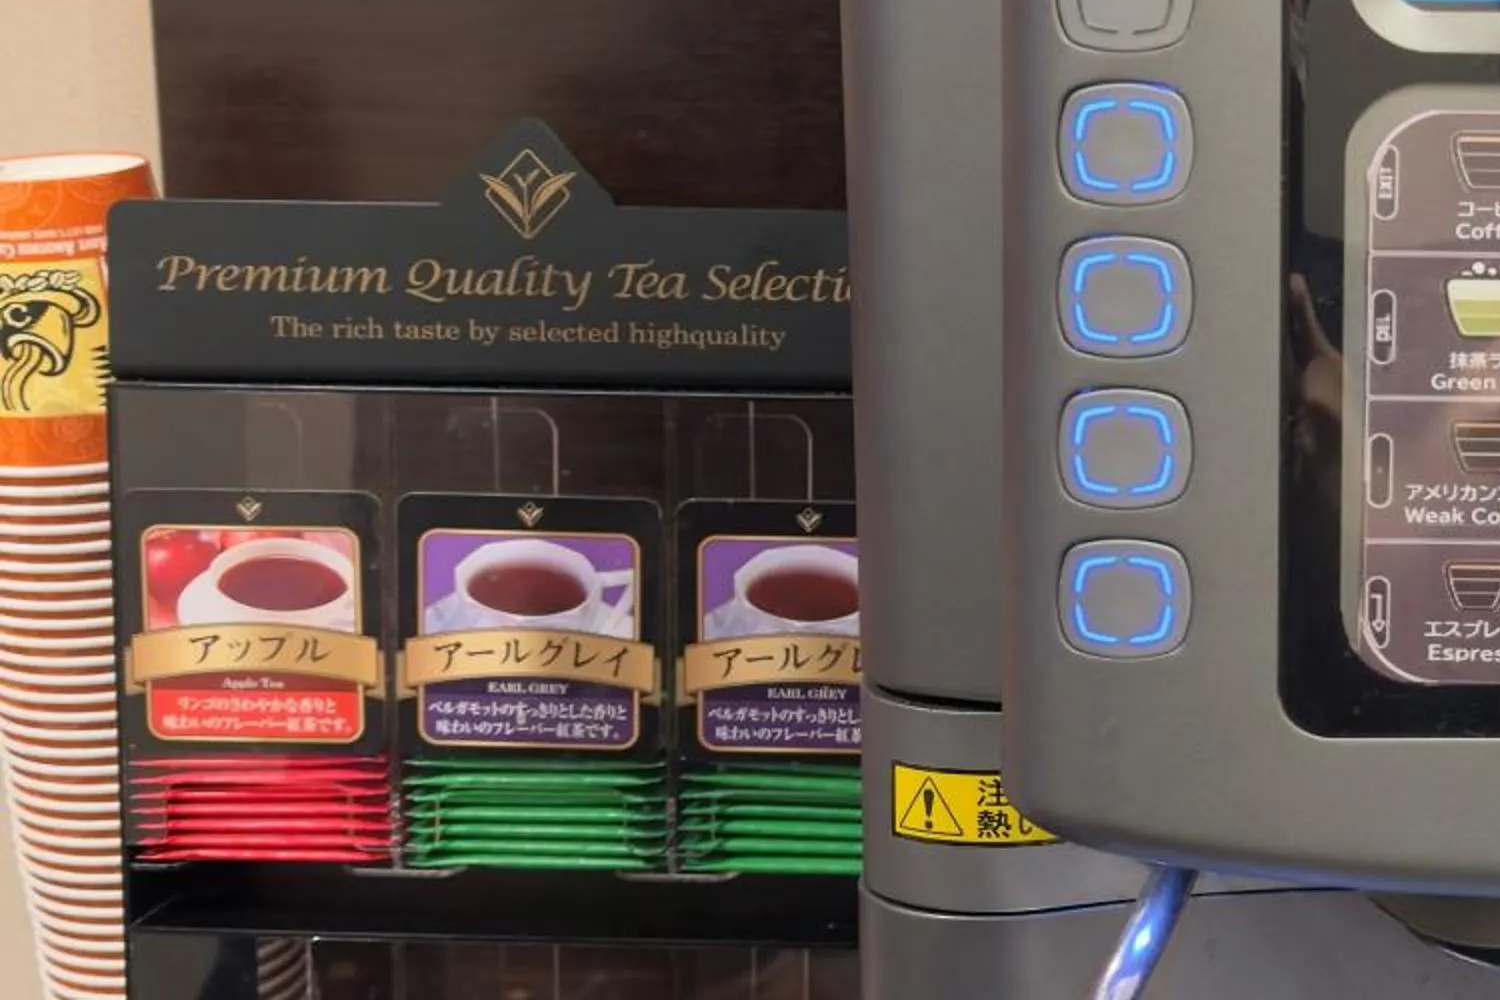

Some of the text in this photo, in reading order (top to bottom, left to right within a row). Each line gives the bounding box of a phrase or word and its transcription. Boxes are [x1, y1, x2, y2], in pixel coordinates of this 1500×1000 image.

[157, 255, 852, 312] Premium Quality Tea Selecti
[271, 315, 787, 350] The rich taste by selected highquality
[1430, 373, 1497, 391] Green
[1404, 507, 1465, 525] Weak
[188, 633, 330, 665] アップル
[434, 637, 630, 678] アールグレイ
[487, 681, 570, 695] EARL GREY
[767, 687, 805, 699] EARL
